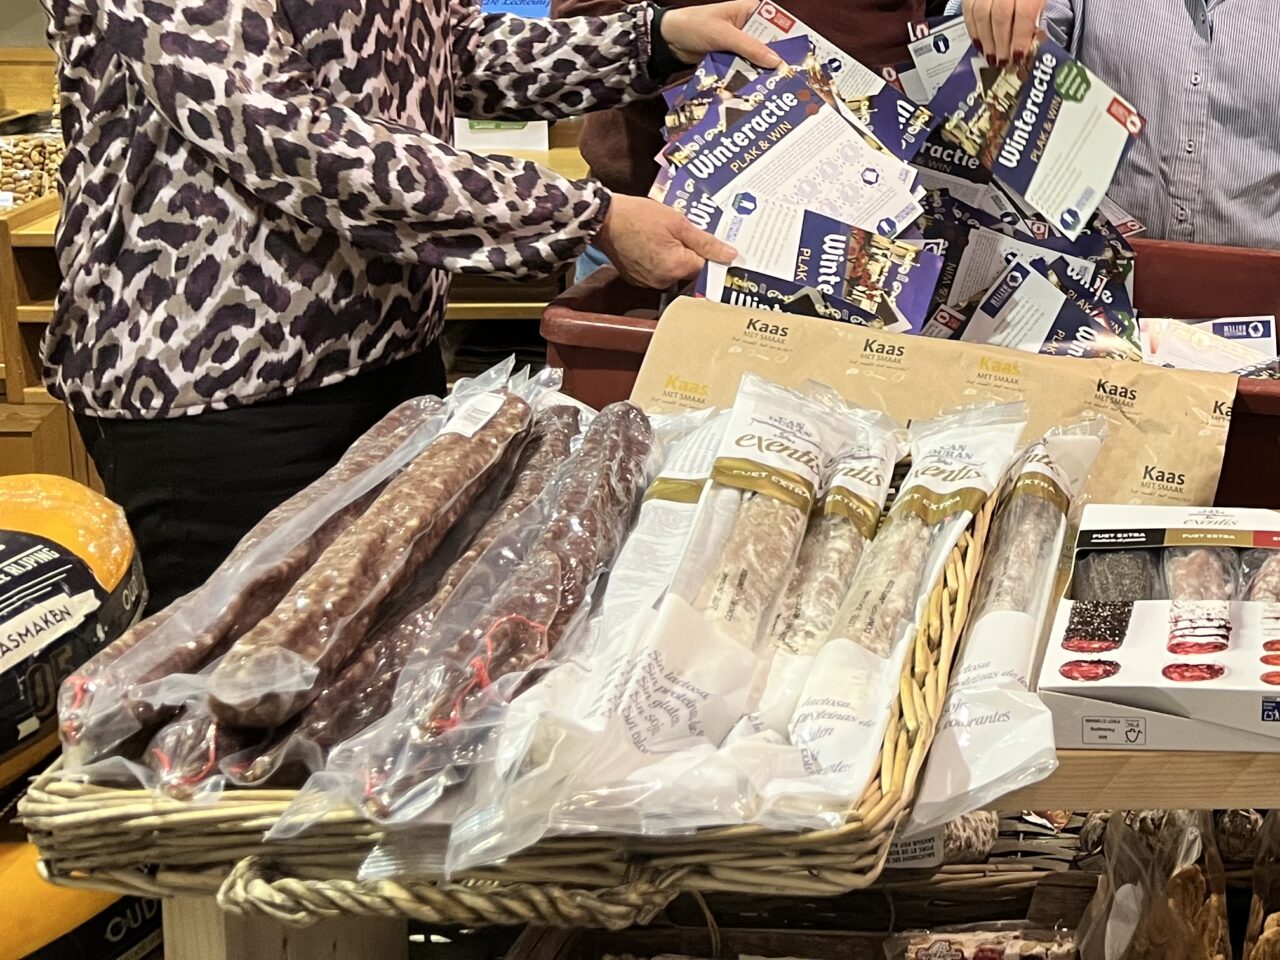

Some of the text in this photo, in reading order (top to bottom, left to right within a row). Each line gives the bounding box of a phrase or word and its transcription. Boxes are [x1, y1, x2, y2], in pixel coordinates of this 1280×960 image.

[998, 52, 1057, 168] Winteractie
[687, 90, 798, 179] Winteractie
[730, 120, 793, 173] PLAK & WIN
[1030, 131, 1047, 163] PLAK
[795, 247, 811, 282] PLAK
[746, 318, 789, 337] Kaas
[863, 338, 905, 357] Kaas
[1045, 328, 1066, 355] PLAK
[979, 356, 1021, 376] Kaas
[664, 375, 709, 395] Kaas
[1097, 379, 1137, 401] Kaas
[735, 433, 820, 476] exentis
[771, 475, 811, 500] EXTRA
[1143, 465, 1185, 485] Kaas
[922, 496, 961, 511] EXTRA
[1116, 531, 1146, 539] EXTRA
[13, 548, 60, 577] RIJPING
